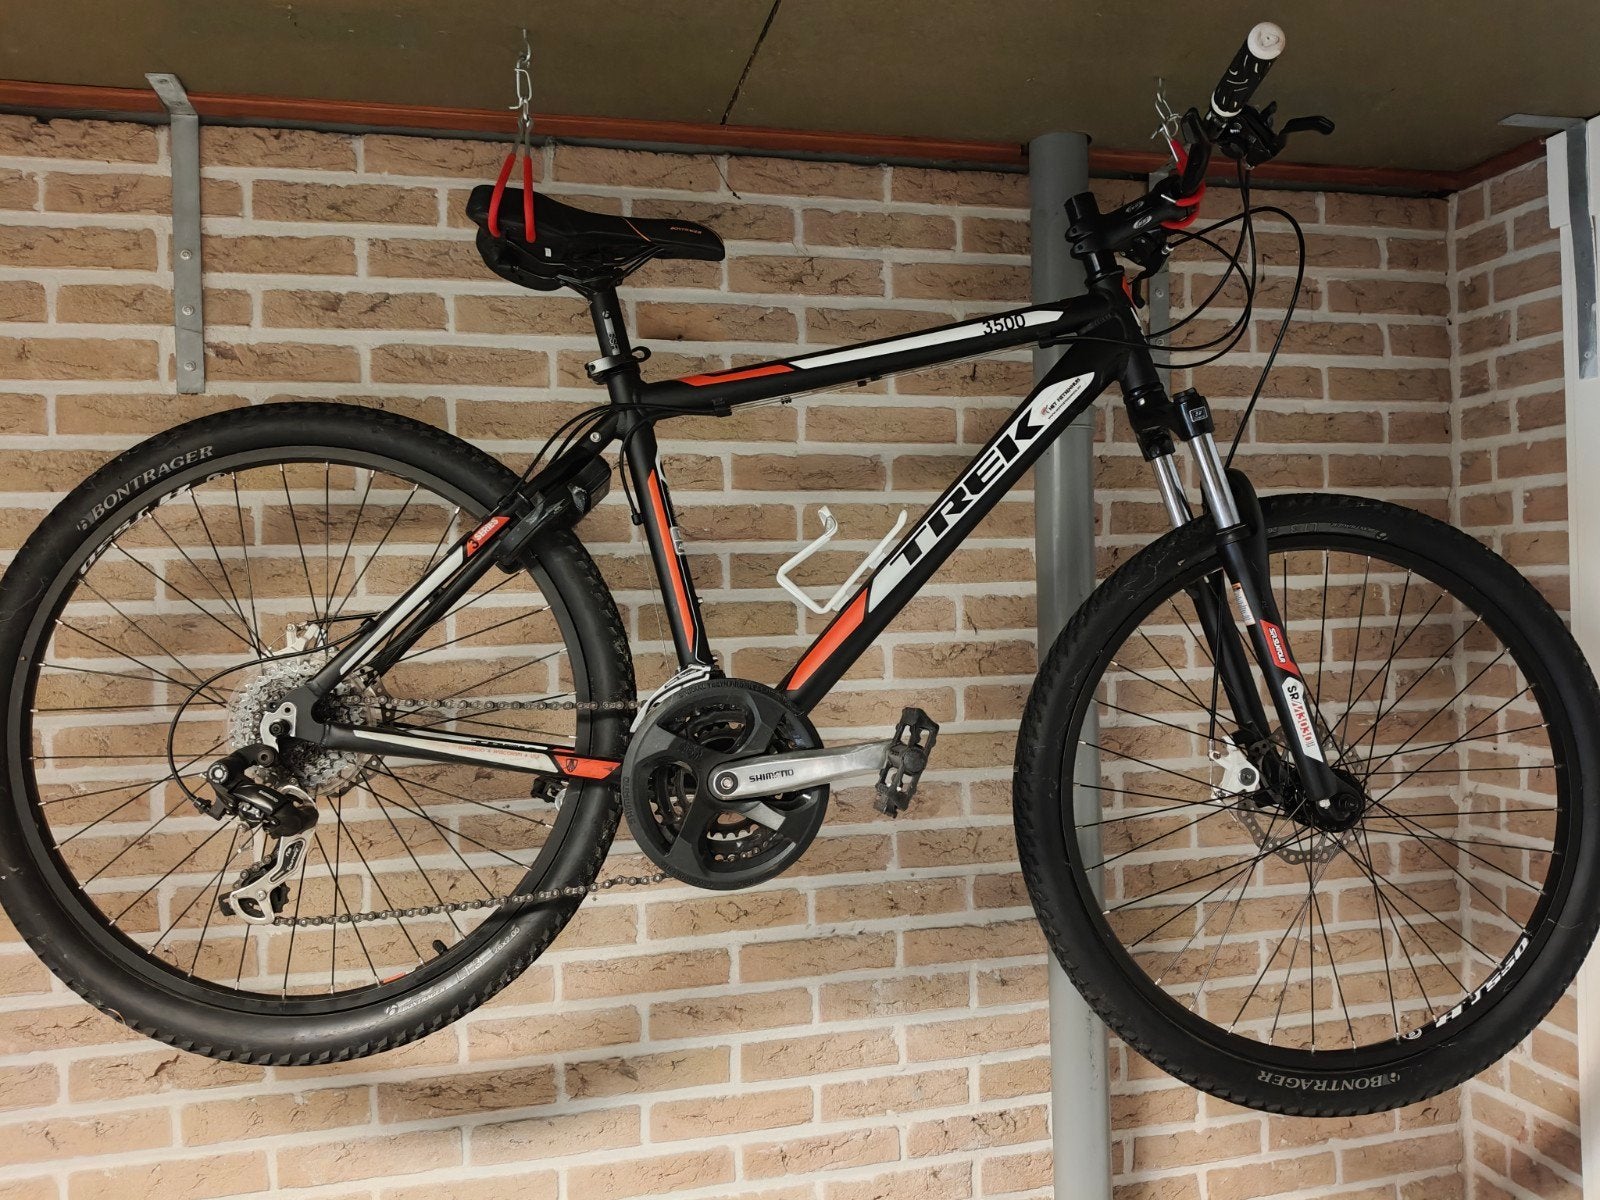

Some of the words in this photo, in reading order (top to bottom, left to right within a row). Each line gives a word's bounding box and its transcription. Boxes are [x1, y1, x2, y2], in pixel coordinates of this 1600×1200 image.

[982, 313, 1026, 335] 3500
[91, 445, 213, 522] BONTRAGER
[889, 406, 1045, 566] TREK
[467, 536, 479, 548] 3
[473, 518, 499, 540] SERIES
[1257, 1070, 1382, 1090] BONTRAGER
